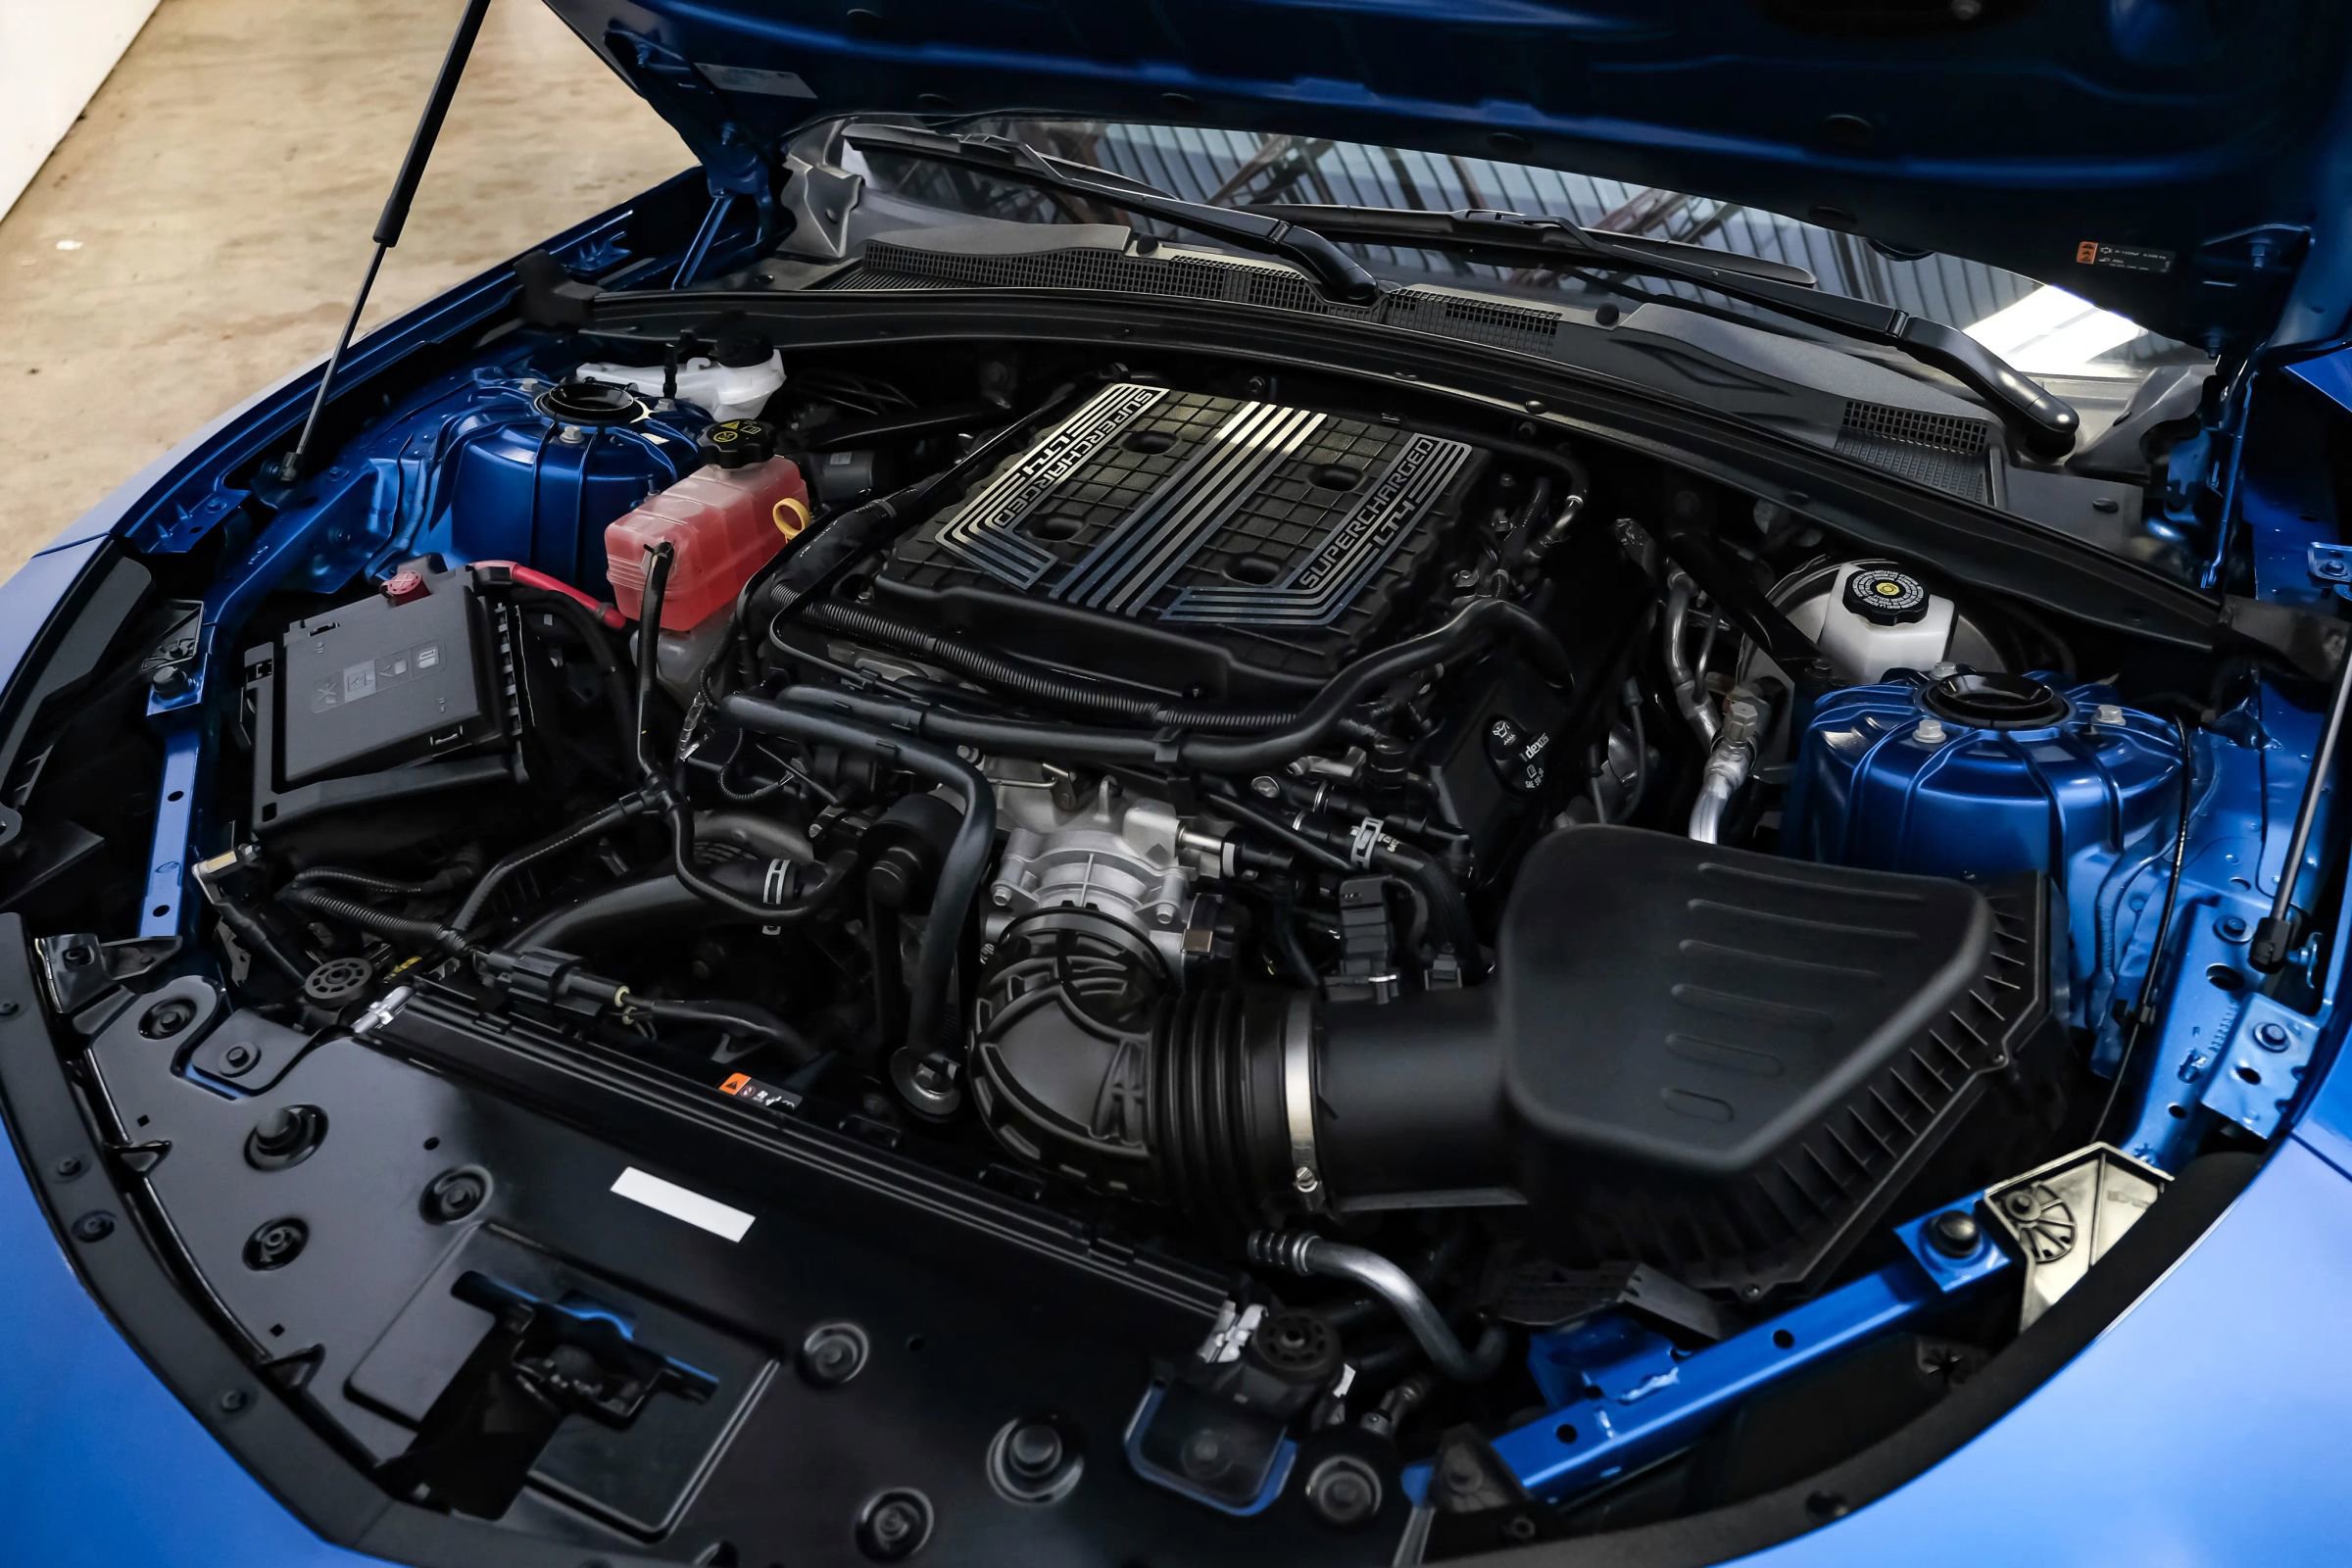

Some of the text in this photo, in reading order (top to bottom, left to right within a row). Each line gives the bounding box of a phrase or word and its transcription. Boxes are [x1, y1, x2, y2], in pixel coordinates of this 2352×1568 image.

[993, 390, 1153, 527] SUPERCHARGED
[1022, 435, 1071, 475] LT4
[1298, 438, 1434, 588] SUPERCHARGED
[1373, 500, 1416, 548] LT4
